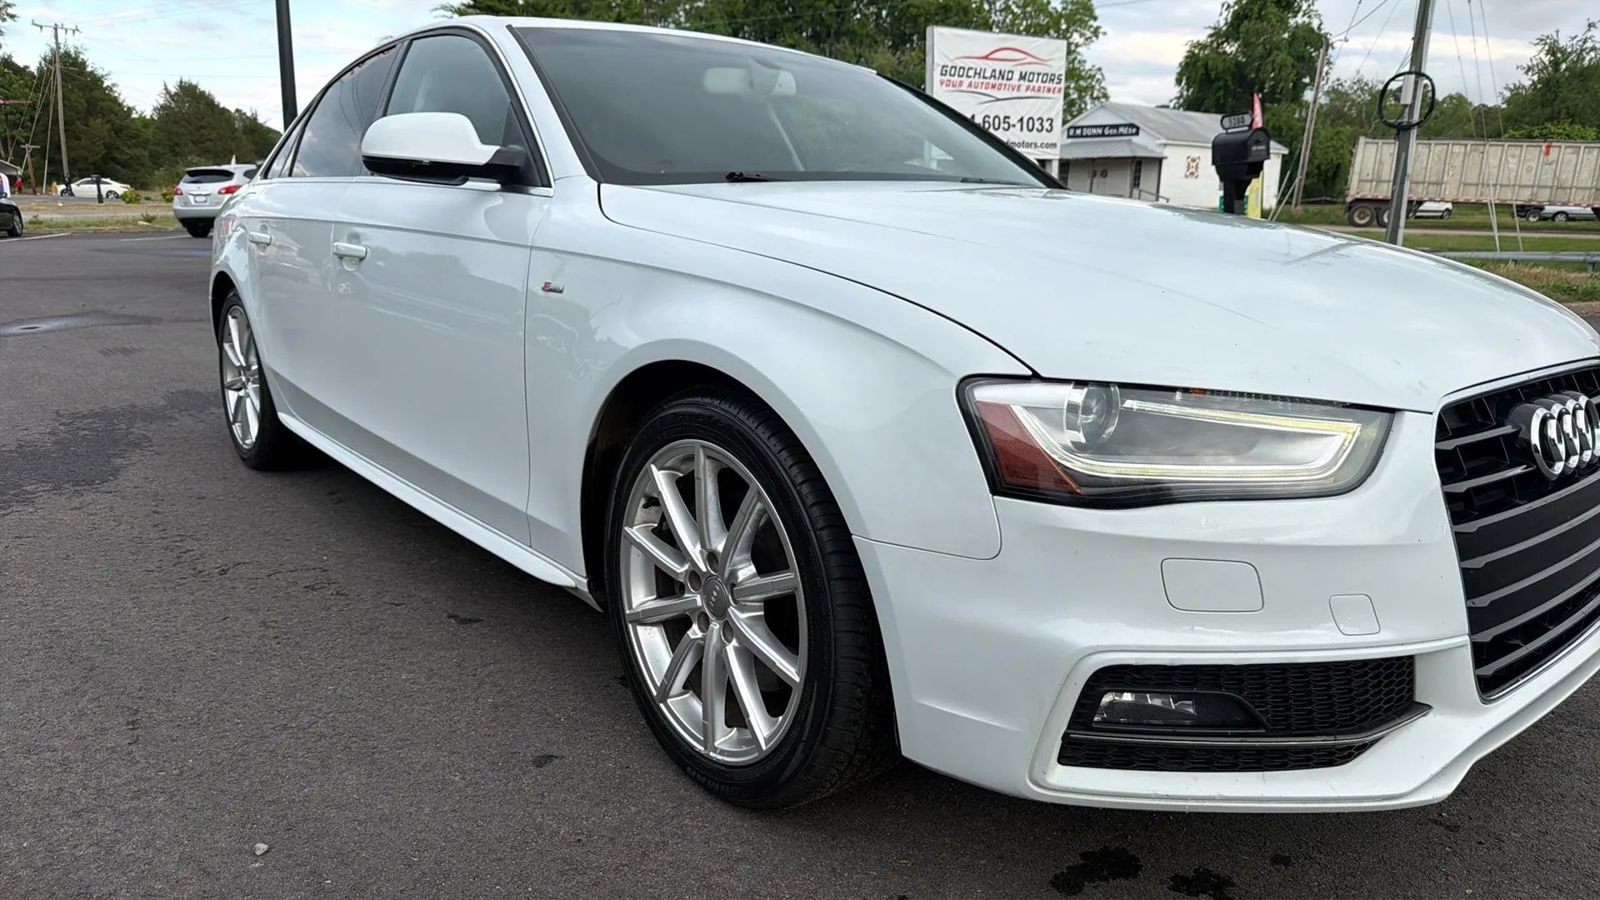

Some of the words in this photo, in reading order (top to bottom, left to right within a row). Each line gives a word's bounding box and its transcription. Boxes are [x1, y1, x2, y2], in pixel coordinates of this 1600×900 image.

[940, 65, 1014, 81] GOOCHLAND
[1019, 70, 1063, 85] MOTORS
[939, 79, 963, 88] YOUR
[967, 81, 1021, 92] AUTOMOTIVE
[1025, 85, 1063, 95] PARTNER
